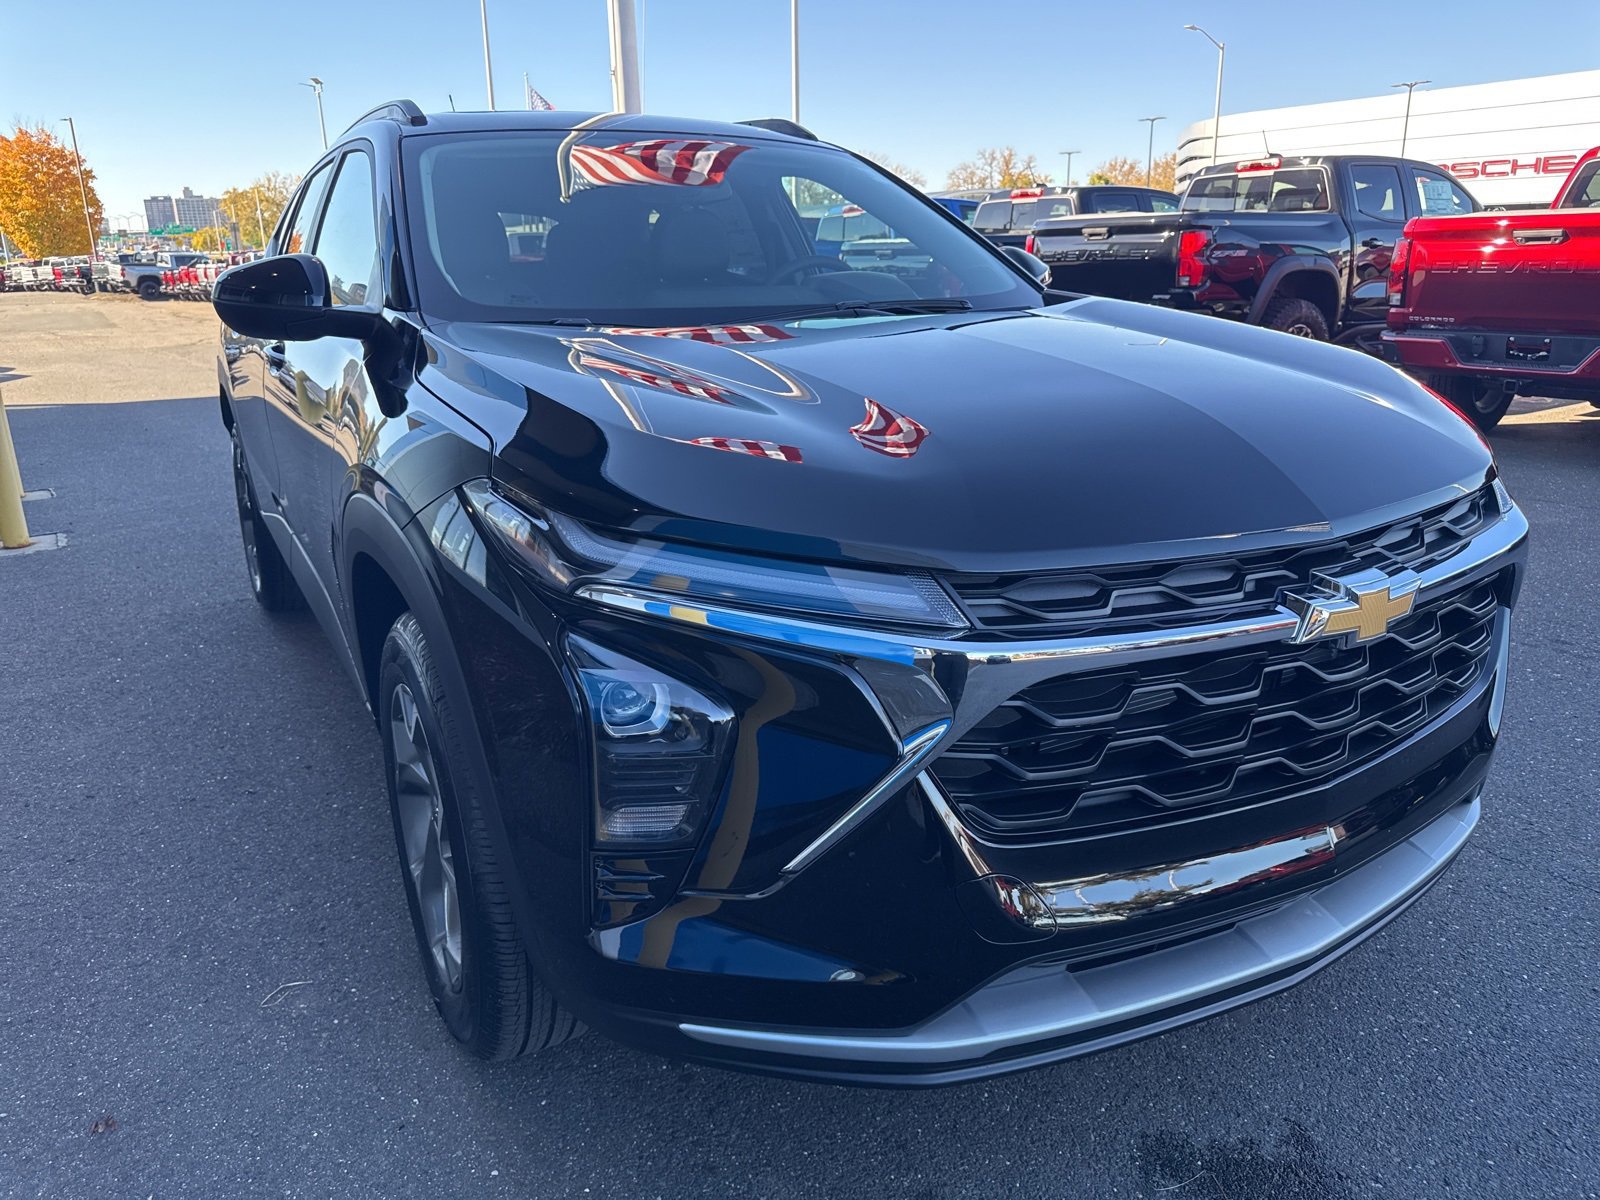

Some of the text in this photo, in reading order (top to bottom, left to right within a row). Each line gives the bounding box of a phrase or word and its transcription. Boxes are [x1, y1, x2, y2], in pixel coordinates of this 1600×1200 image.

[1042, 250, 1157, 261] CHEVROLET
[1431, 260, 1600, 274] CHEVROL
[1408, 315, 1455, 323] COLORADO
